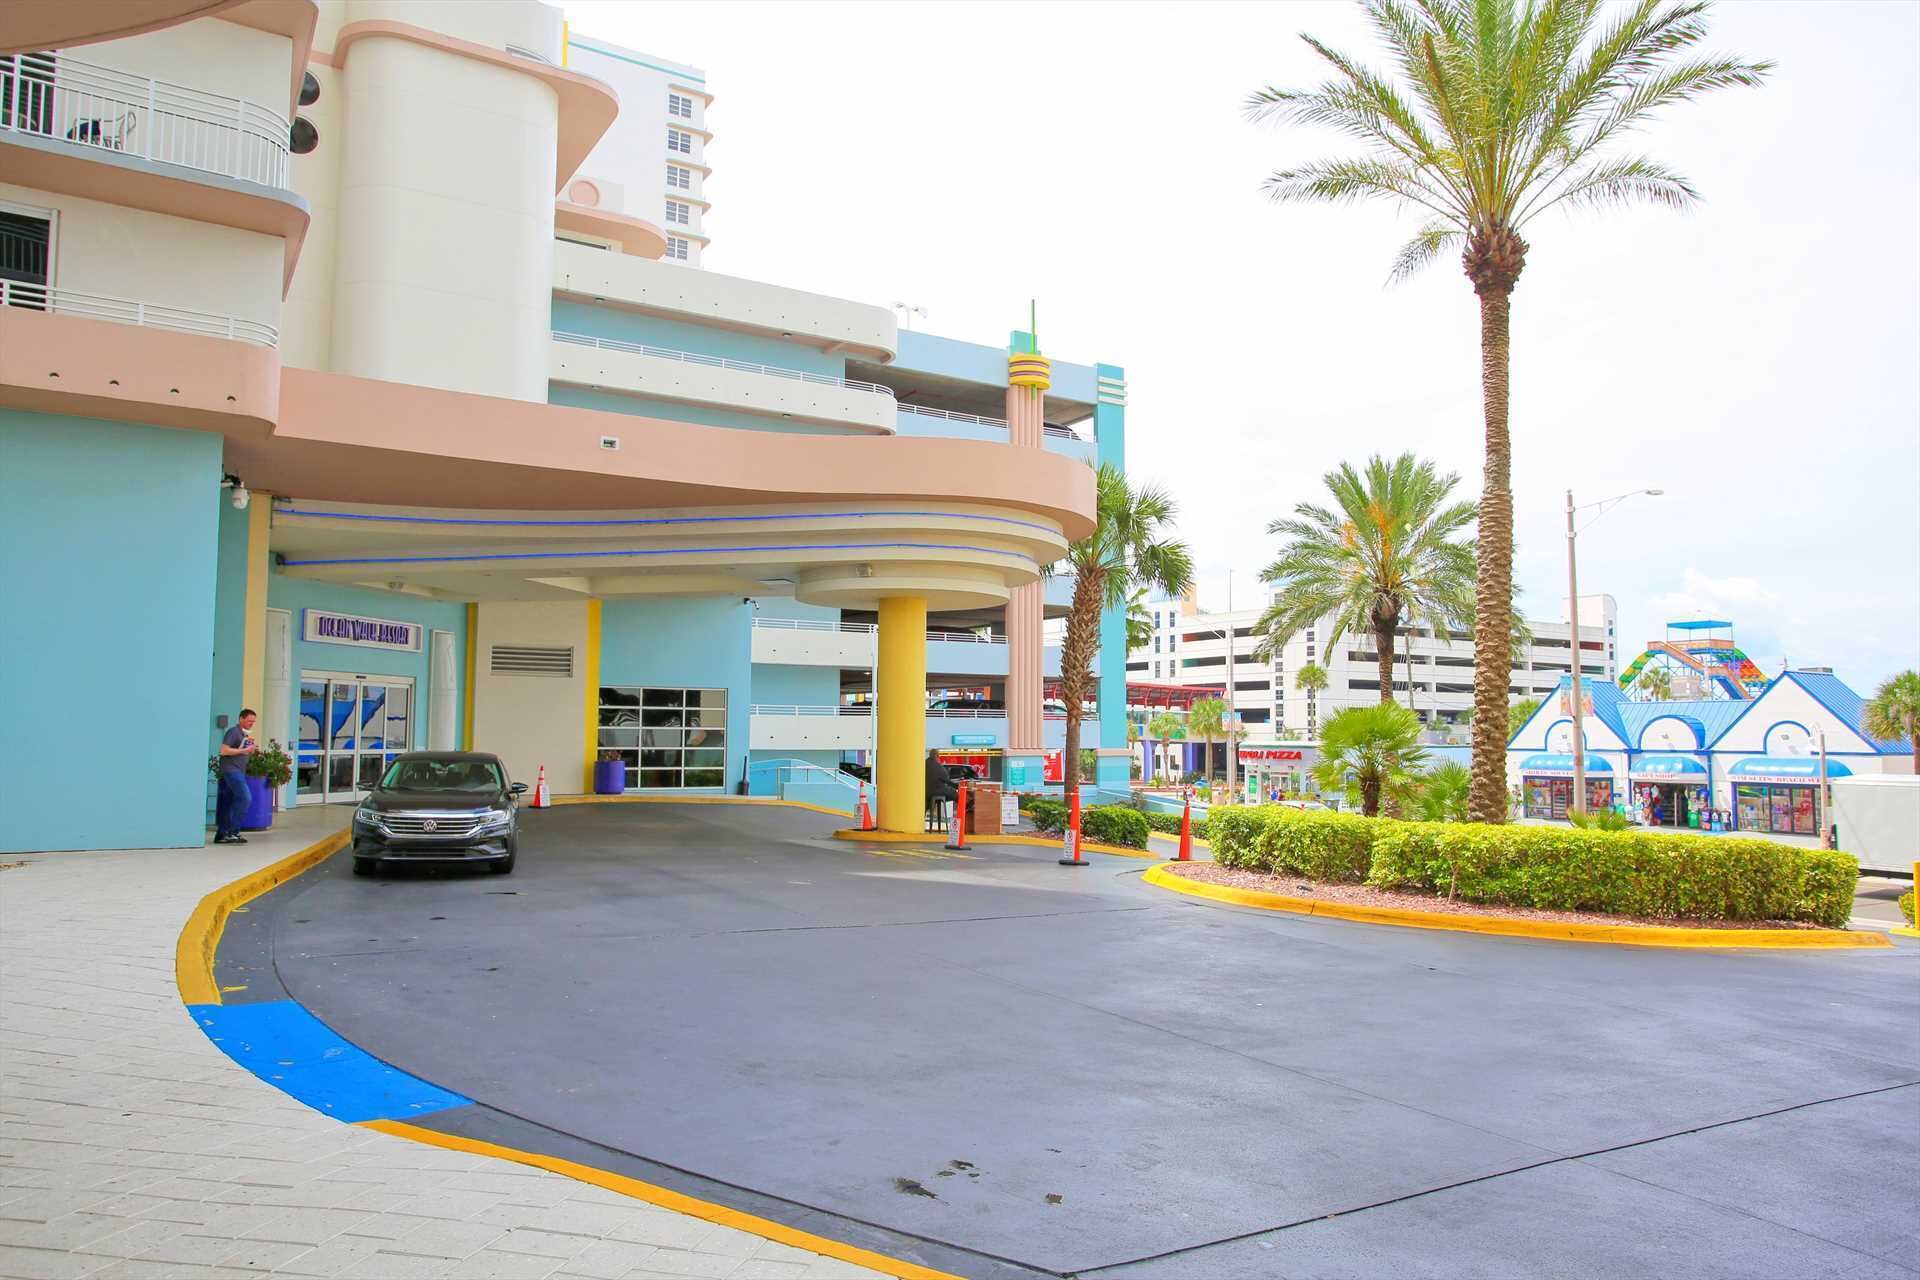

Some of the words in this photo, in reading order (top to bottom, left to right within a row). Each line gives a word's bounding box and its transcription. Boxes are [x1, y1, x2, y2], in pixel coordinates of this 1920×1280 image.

[351, 619, 378, 641] WALK
[378, 623, 409, 645] RESORT
[1265, 750, 1303, 760] PIZZA
